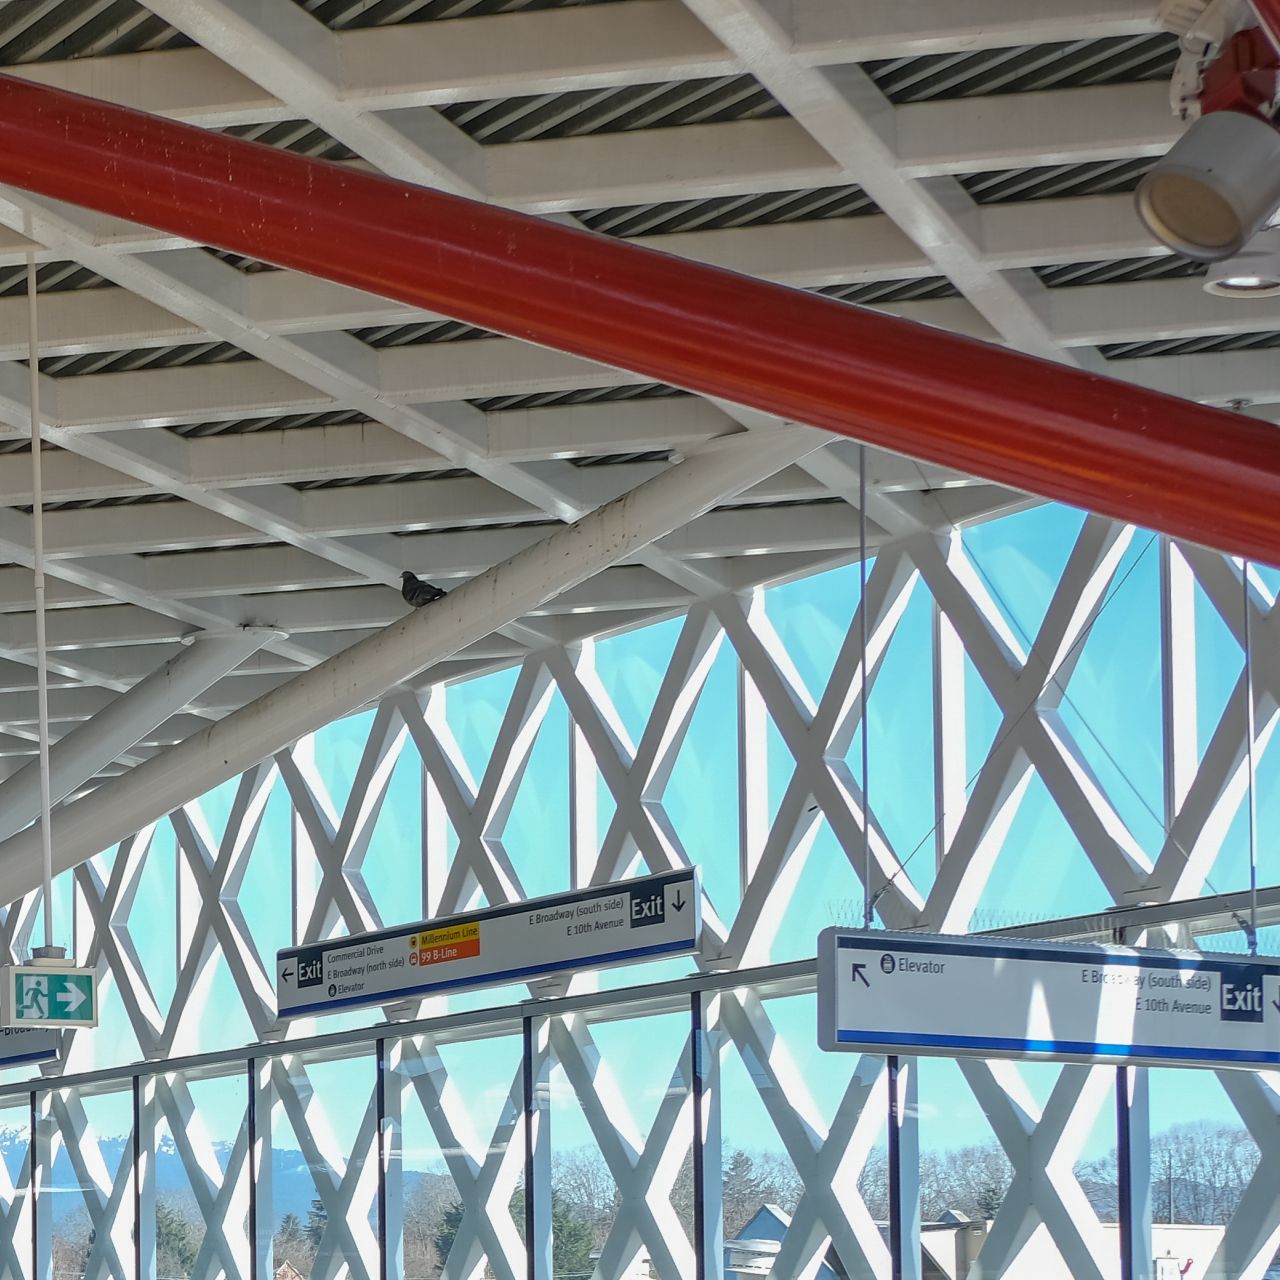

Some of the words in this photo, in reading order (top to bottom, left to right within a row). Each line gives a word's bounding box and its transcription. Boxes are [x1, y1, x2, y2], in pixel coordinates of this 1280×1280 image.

[528, 915, 535, 925] E
[535, 908, 575, 924] Broadway
[576, 902, 602, 918] (south
[603, 896, 624, 913] side)
[631, 894, 664, 920] Exit
[420, 930, 461, 946] Millennium
[462, 926, 478, 938] Line
[567, 926, 573, 937] E
[573, 922, 593, 935] 10th
[594, 917, 625, 932] Avenue
[327, 949, 366, 964] Commercial
[366, 944, 384, 957] Drive
[421, 951, 431, 963] 99
[432, 948, 458, 961] B-Line
[297, 962, 323, 982] Exit
[327, 969, 332, 979] E
[332, 963, 365, 980] Broadway
[366, 959, 388, 974] (north
[388, 957, 405, 970] side)
[898, 956, 946, 976] Elevator
[338, 981, 365, 995] Elevator
[1082, 969, 1089, 983] E
[1091, 970, 1146, 989] Broay
[1148, 972, 1182, 989] (south
[1185, 975, 1212, 993] side)
[1135, 997, 1142, 1011] E
[1145, 997, 1170, 1013] 10th
[1172, 999, 1213, 1015] Avenue
[1221, 983, 1262, 1012] Exit
